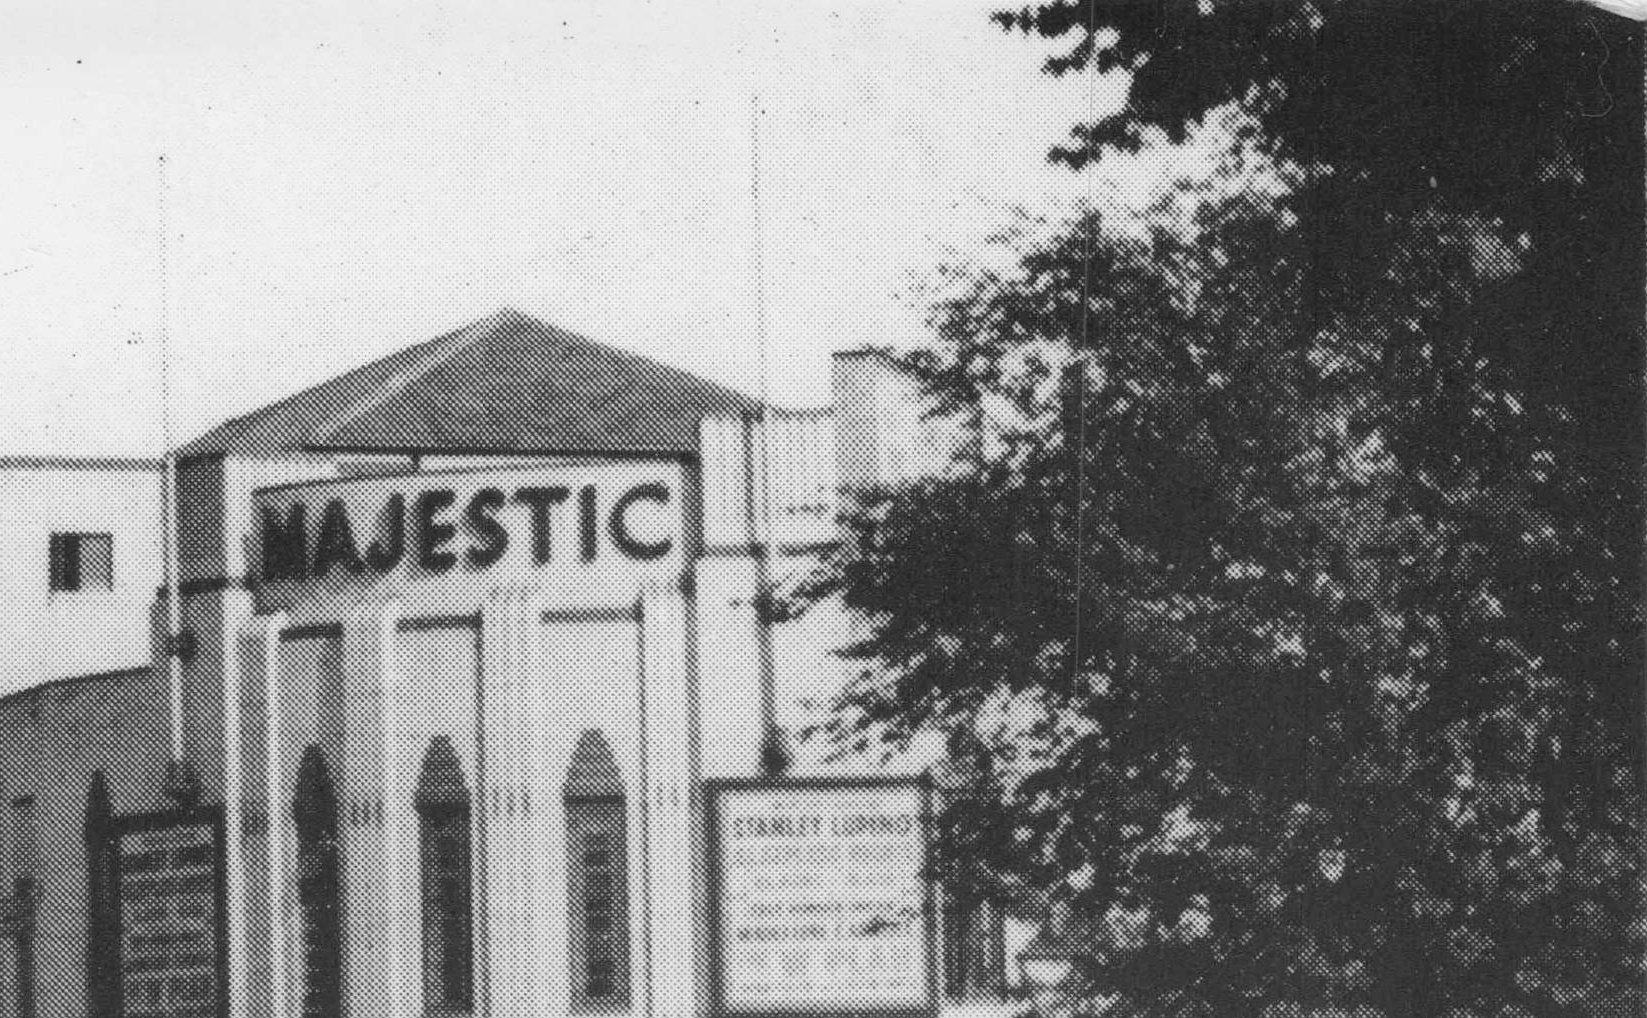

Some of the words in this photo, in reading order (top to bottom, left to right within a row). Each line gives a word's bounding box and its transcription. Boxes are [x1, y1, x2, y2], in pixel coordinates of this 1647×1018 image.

[259, 481, 673, 580] MAJESTIC
[732, 813, 823, 838] STANLEY
[831, 811, 914, 836] LUPINO
